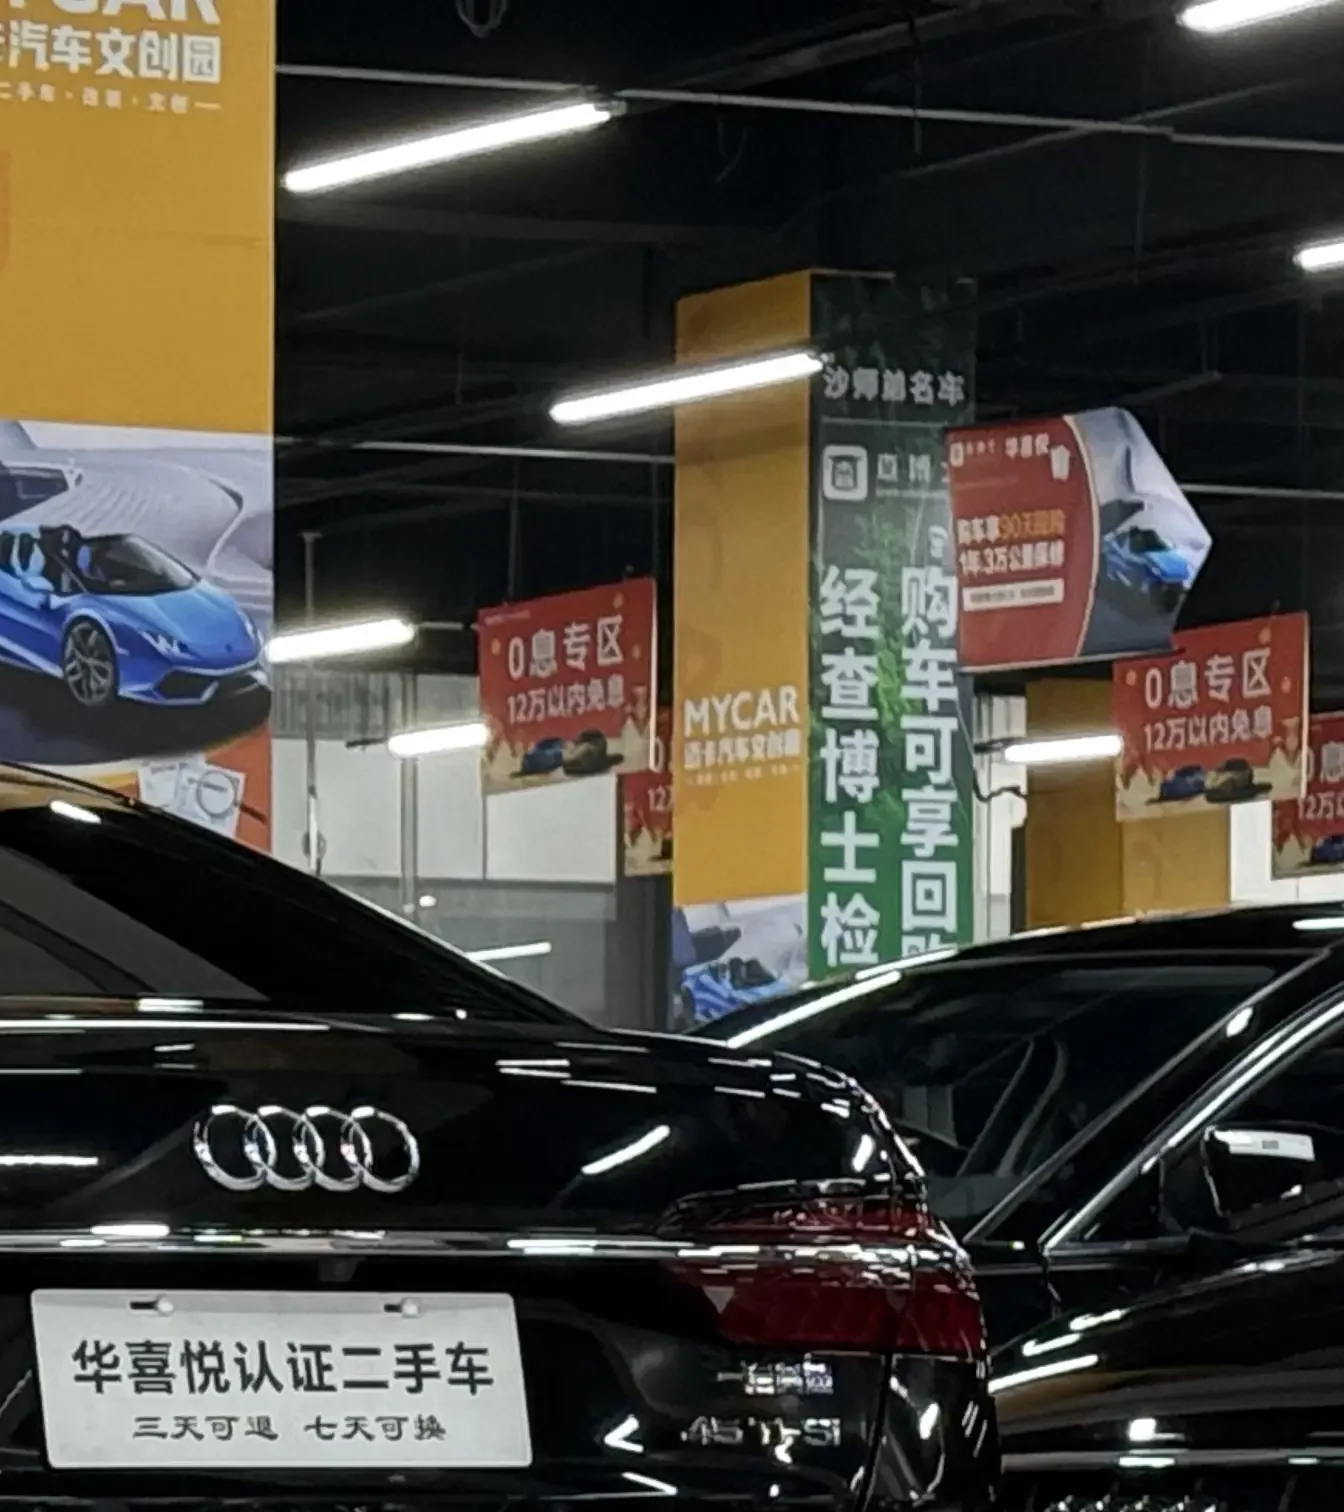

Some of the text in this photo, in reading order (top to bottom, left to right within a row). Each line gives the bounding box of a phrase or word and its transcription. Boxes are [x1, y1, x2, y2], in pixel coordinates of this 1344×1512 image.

[508, 615, 624, 681] 0息专区
[507, 674, 624, 723] 12万以内免息
[1145, 647, 1272, 710] 0息专区
[684, 684, 801, 737] MYCAR
[1144, 705, 1273, 752] 12万以内免息
[820, 565, 880, 967] 经查博士检
[72, 1340, 494, 1395] 华喜悦认证二手车
[133, 1413, 447, 1441] 三天可退 七天可换
